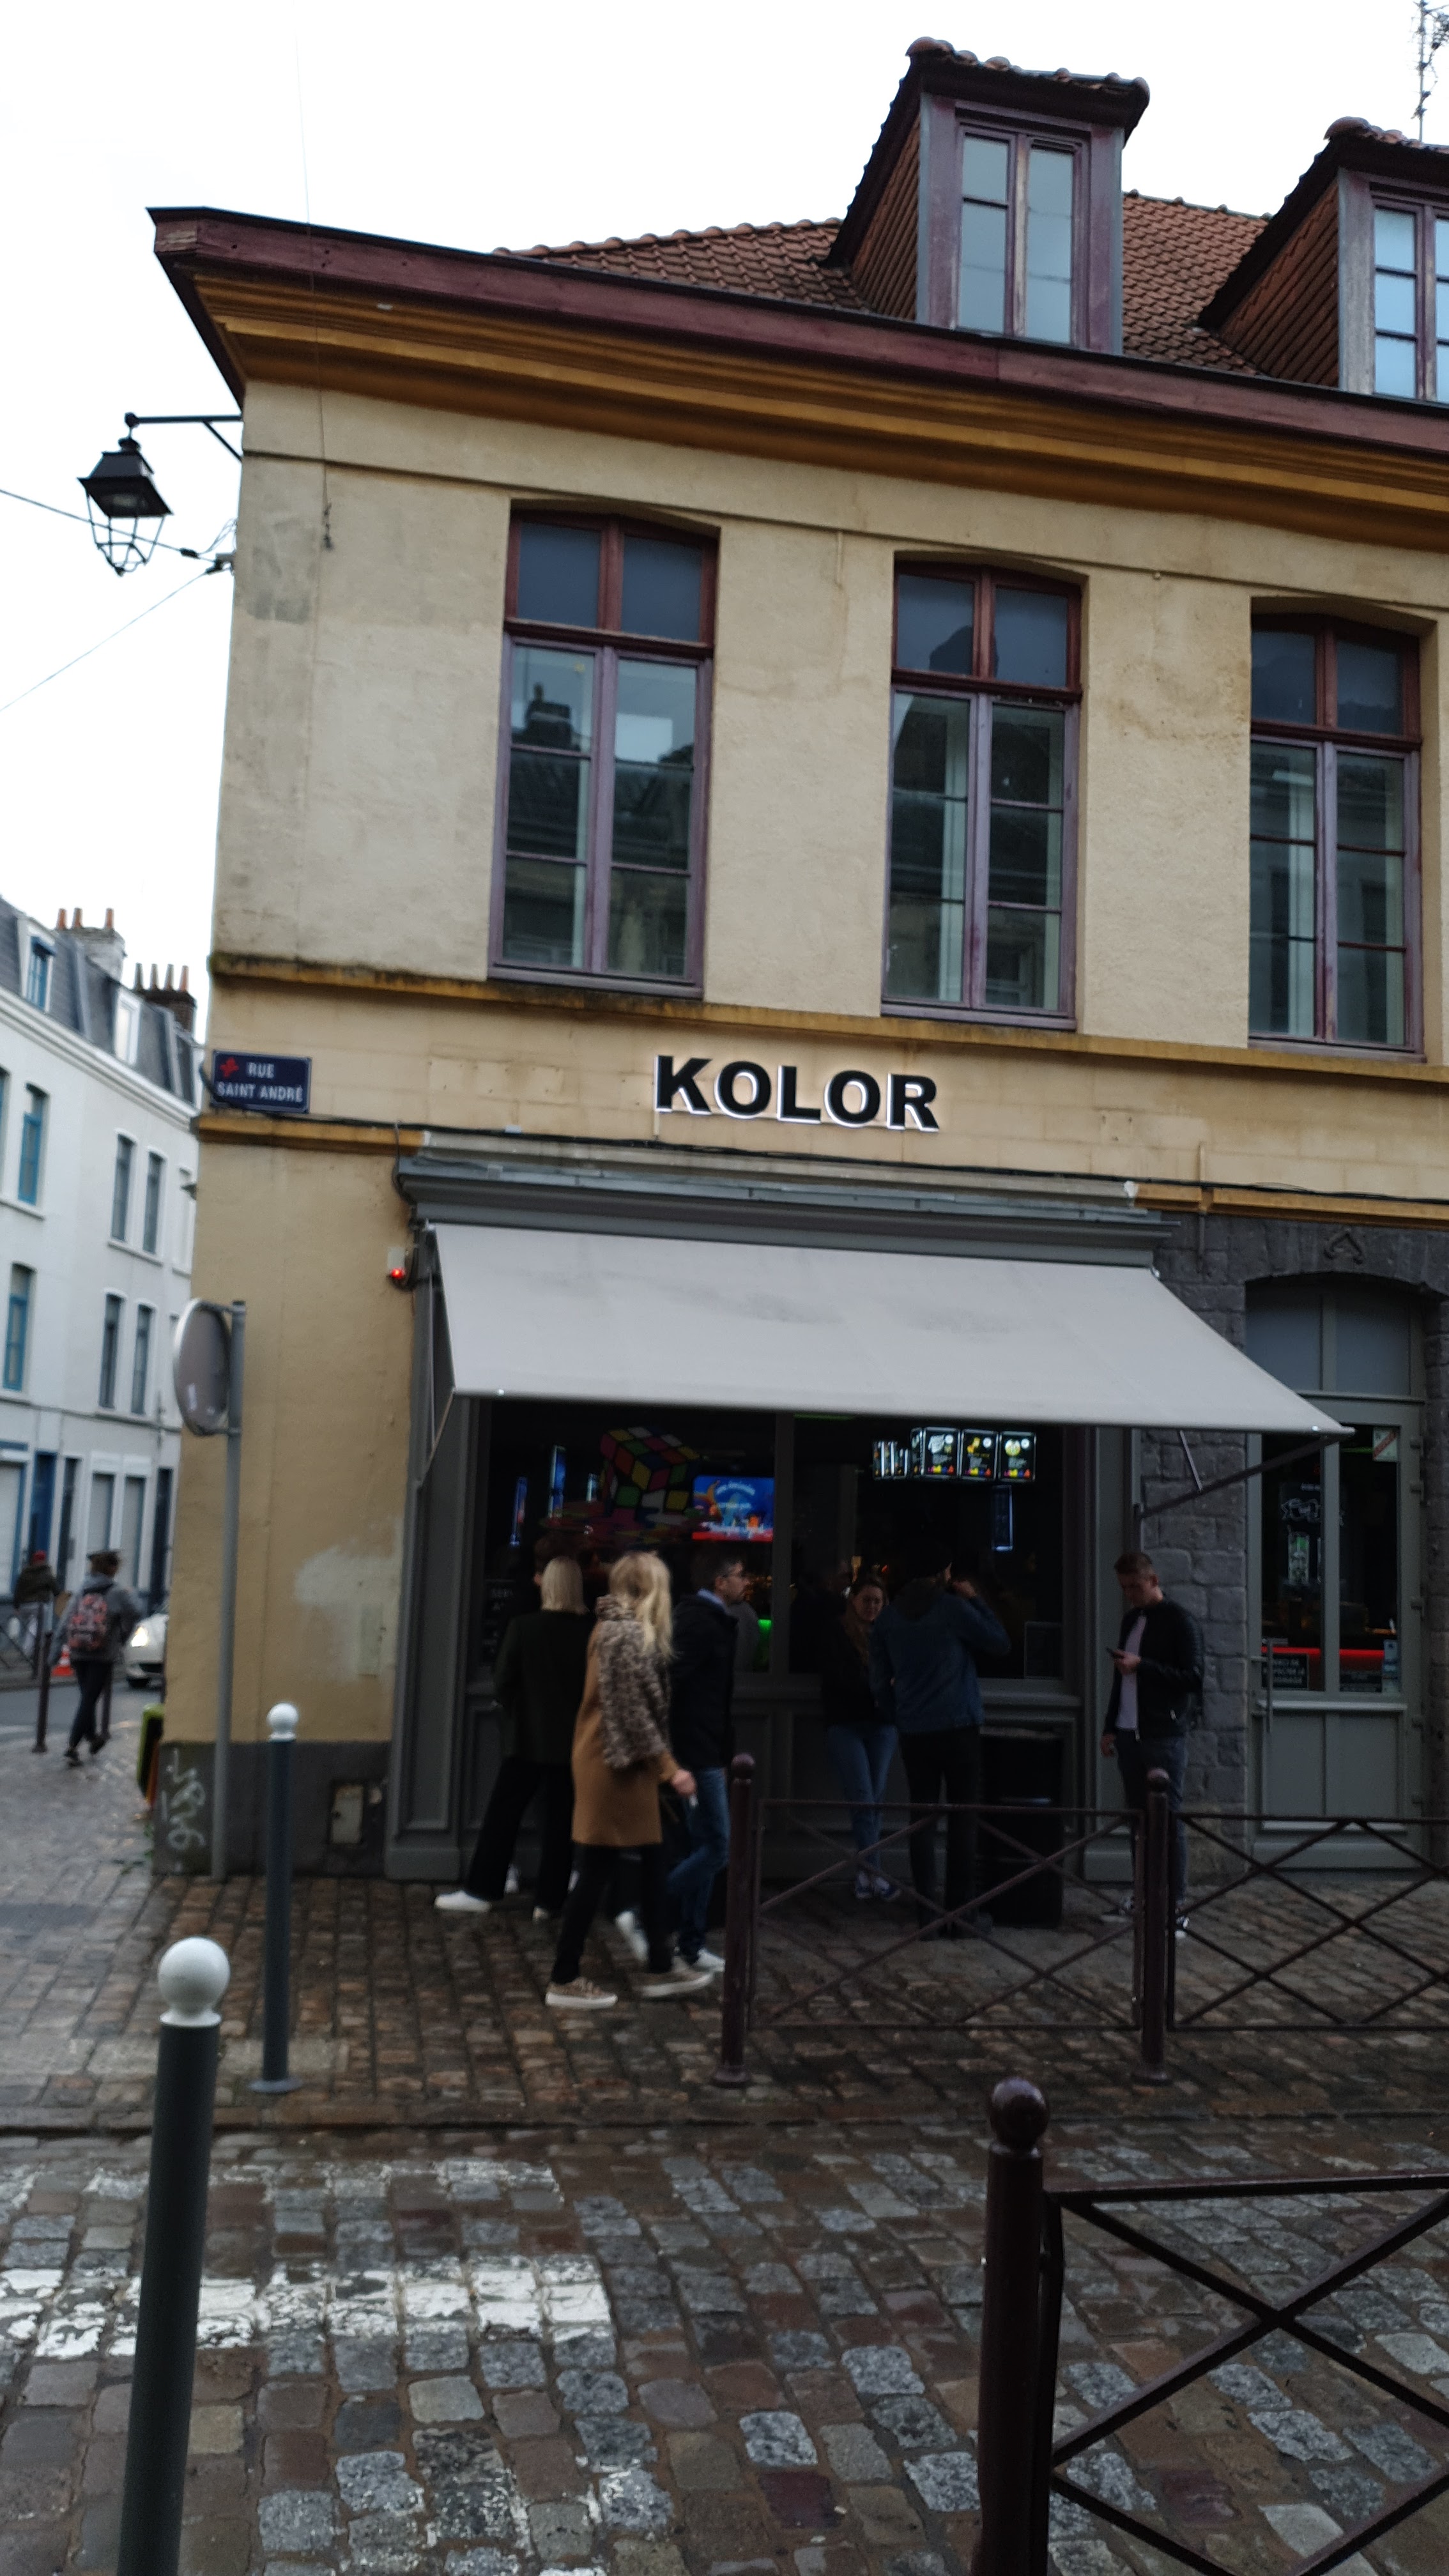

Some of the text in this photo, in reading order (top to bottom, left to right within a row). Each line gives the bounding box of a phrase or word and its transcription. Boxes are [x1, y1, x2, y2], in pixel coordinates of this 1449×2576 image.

[247, 1062, 275, 1078] RUE
[217, 1082, 303, 1102] SAINT ANDRÉ
[655, 1055, 939, 1131] KOLOR
